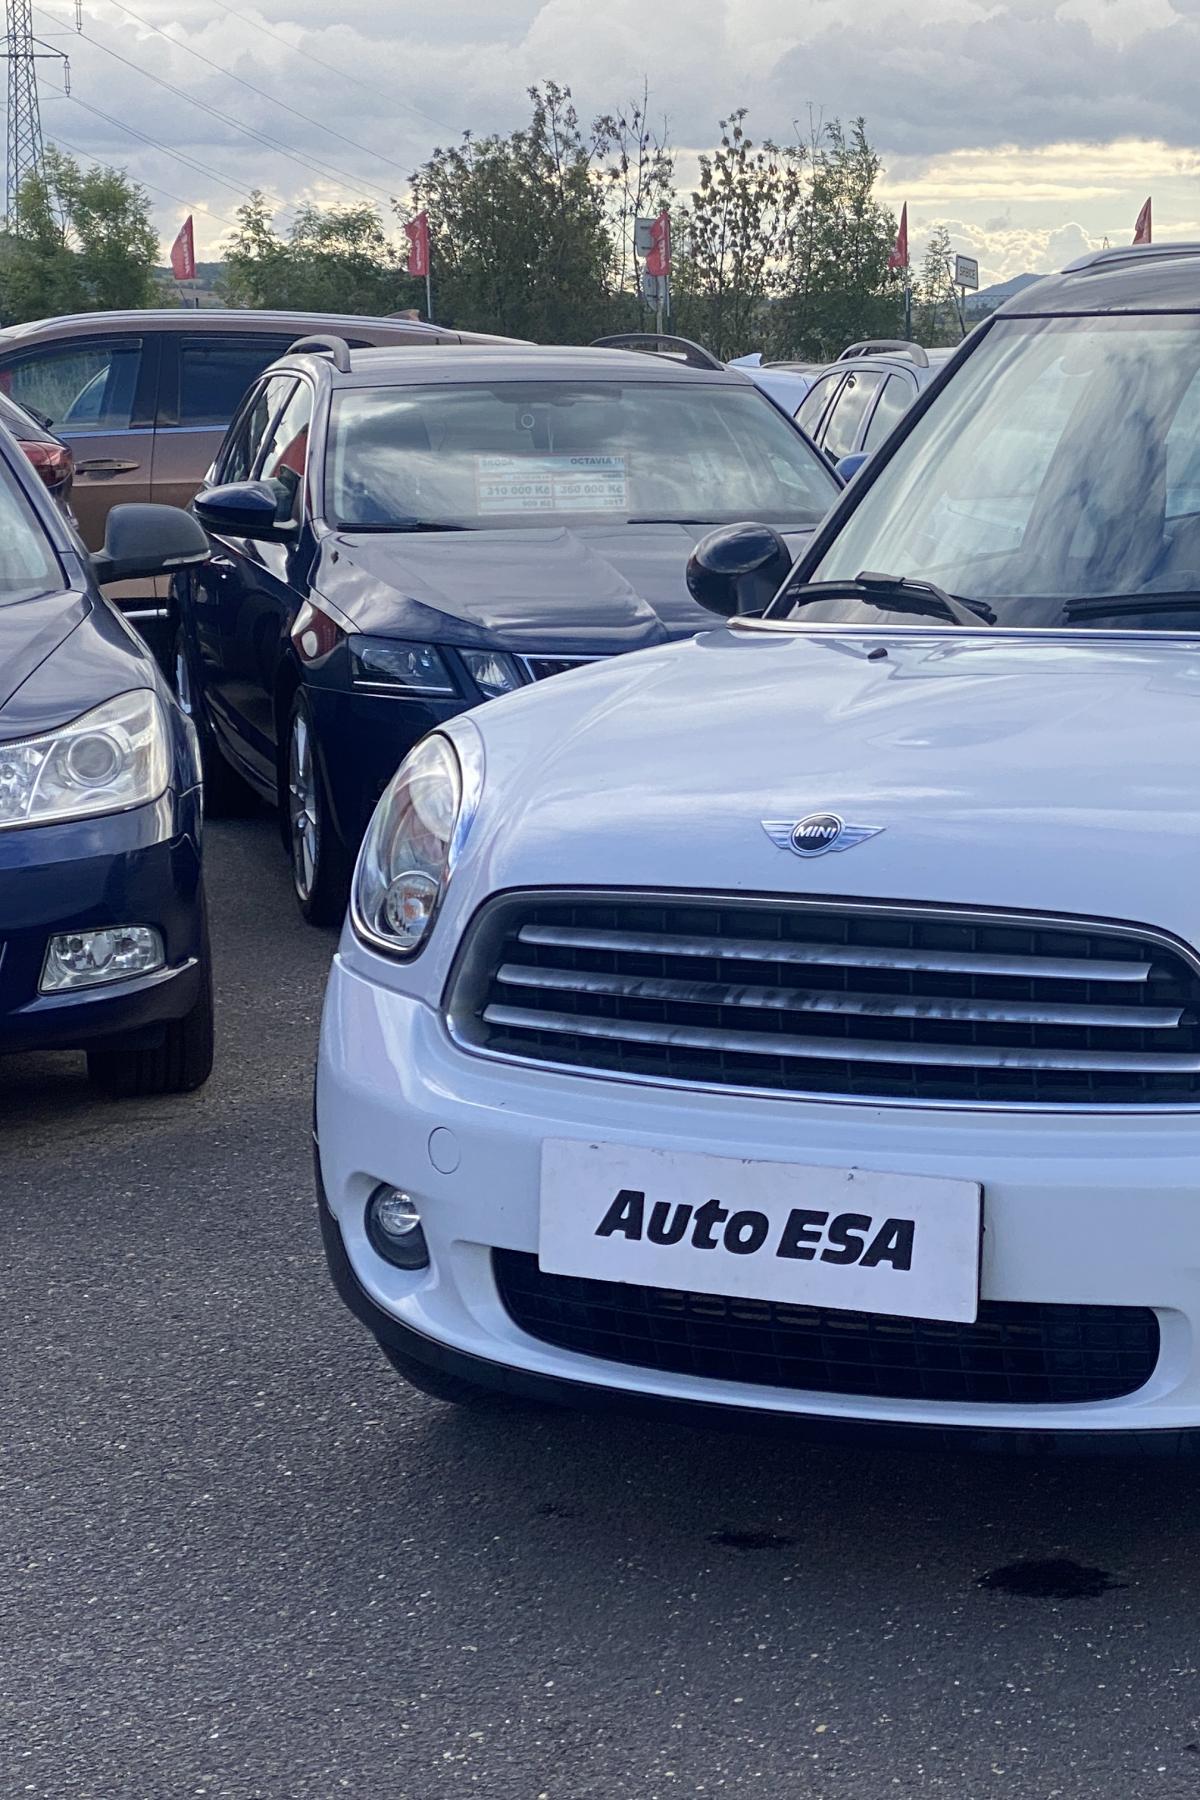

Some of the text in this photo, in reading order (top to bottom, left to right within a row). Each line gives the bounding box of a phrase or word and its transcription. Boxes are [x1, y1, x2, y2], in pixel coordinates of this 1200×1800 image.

[570, 457, 612, 465] OCTAVIA
[511, 486, 532, 495] 000
[795, 825, 837, 839] MINI
[594, 1188, 916, 1272] Auto ESA
